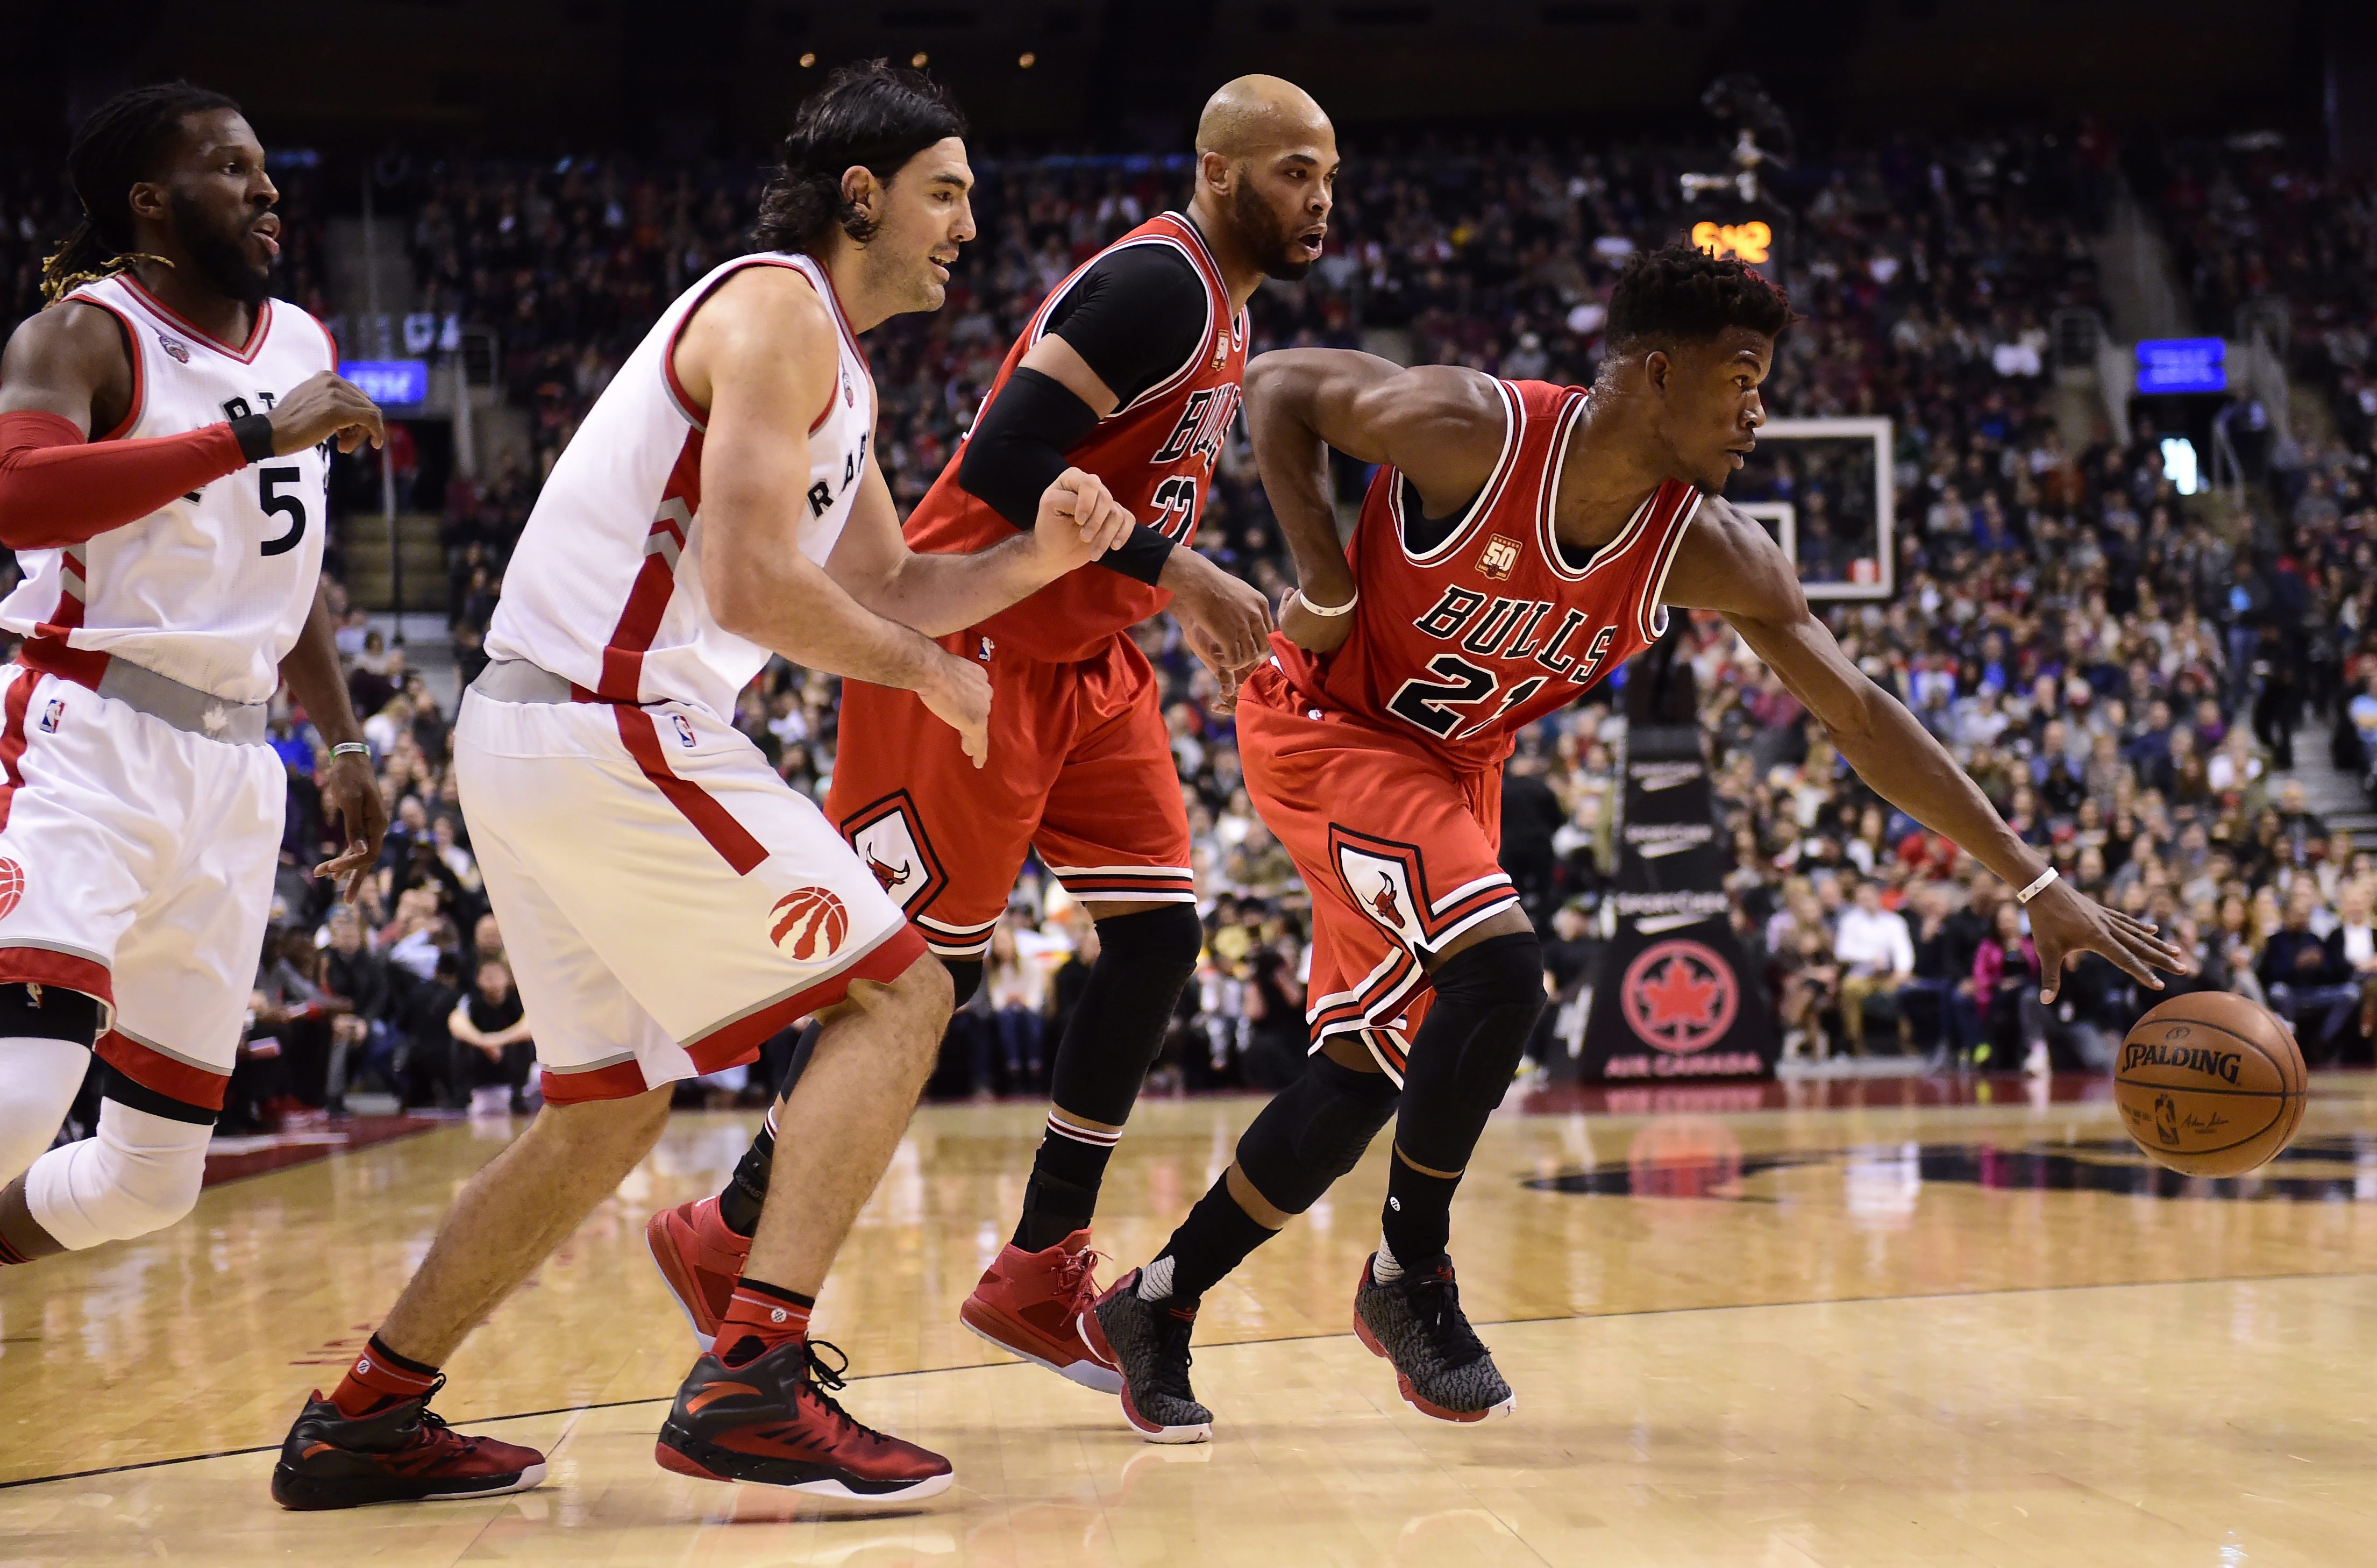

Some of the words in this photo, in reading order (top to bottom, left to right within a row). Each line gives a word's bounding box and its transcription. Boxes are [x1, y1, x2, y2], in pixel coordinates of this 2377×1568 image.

[259, 467, 306, 557] 5
[807, 431, 870, 521] RAP
[1482, 541, 1517, 572] 50
[1412, 583, 1618, 685] BULLS
[1385, 654, 1549, 740] 21
[2123, 1042, 2241, 1085] SPALDING
